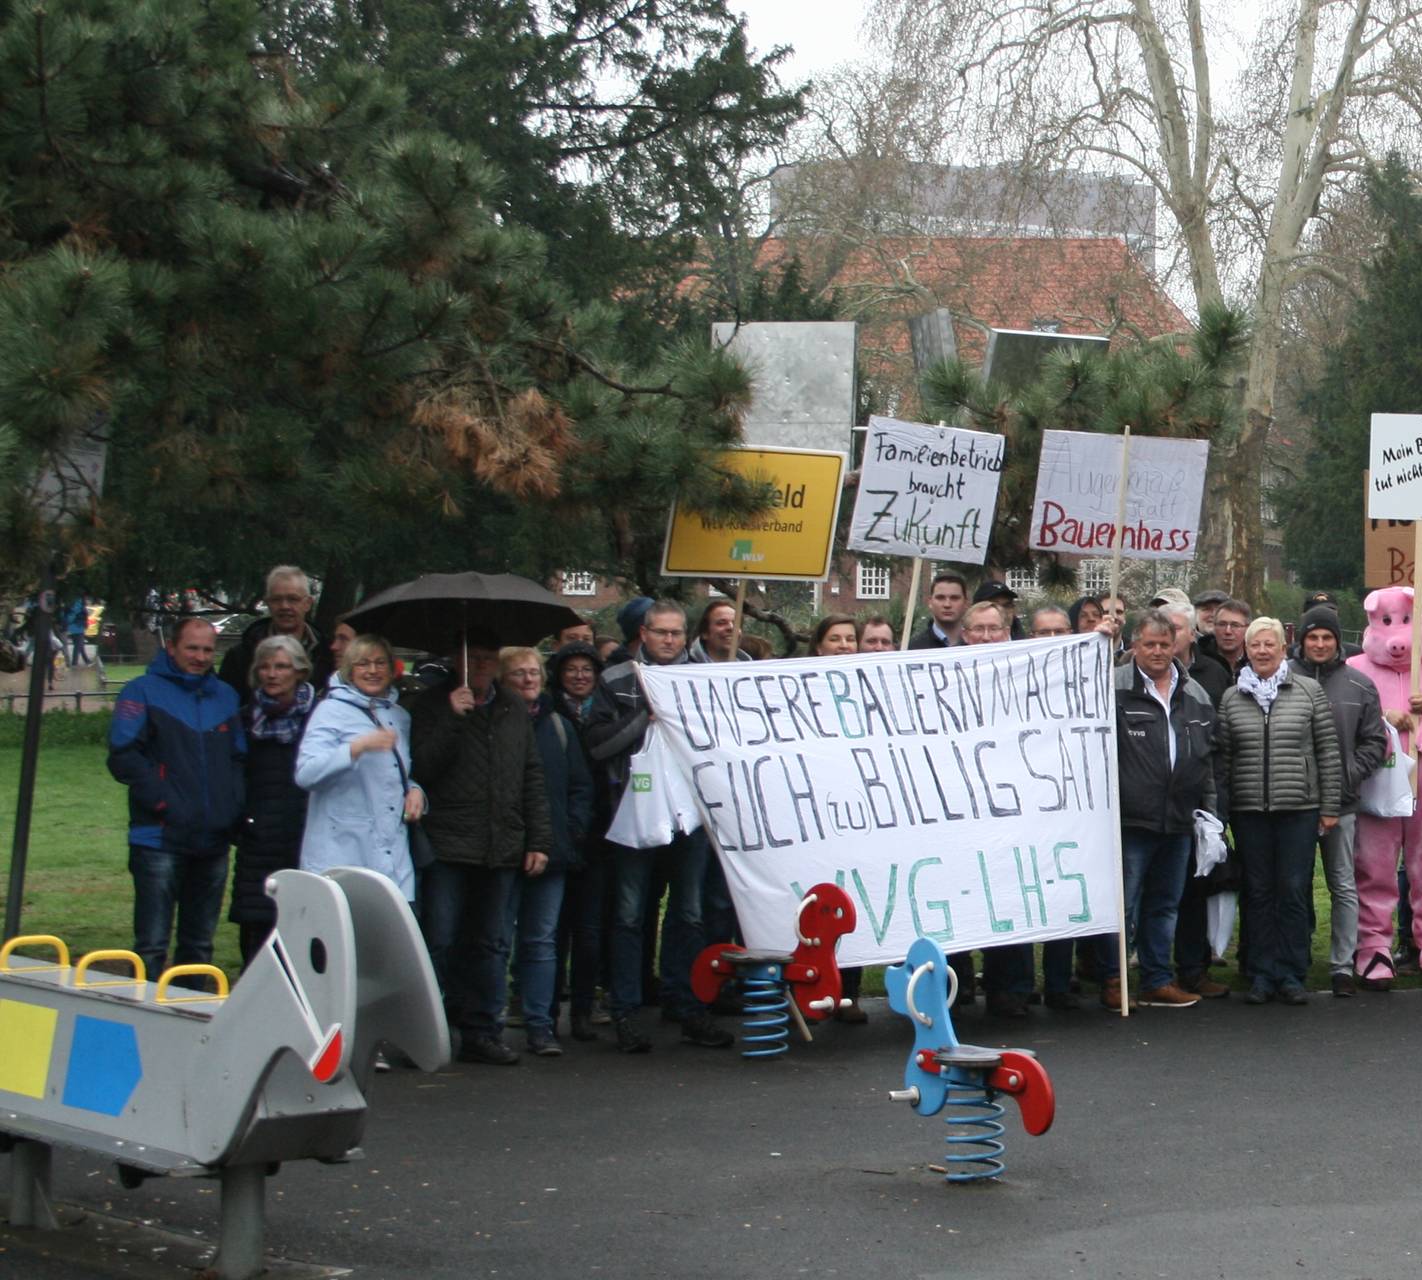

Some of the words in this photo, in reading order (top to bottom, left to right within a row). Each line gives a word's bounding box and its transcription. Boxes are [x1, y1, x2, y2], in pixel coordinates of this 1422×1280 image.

[874, 432, 1004, 473] Familienbetrieb
[1382, 444, 1413, 465] Mein
[906, 471, 965, 500] braucht
[1375, 473, 1393, 492] tut
[1036, 501, 1191, 551] Bauernhass
[671, 675, 838, 752] UNSERE
[825, 659, 984, 740] BAUERN
[992, 641, 1112, 727] MACHEN
[692, 753, 826, 851] EUCH
[1018, 726, 1112, 812] SATT
